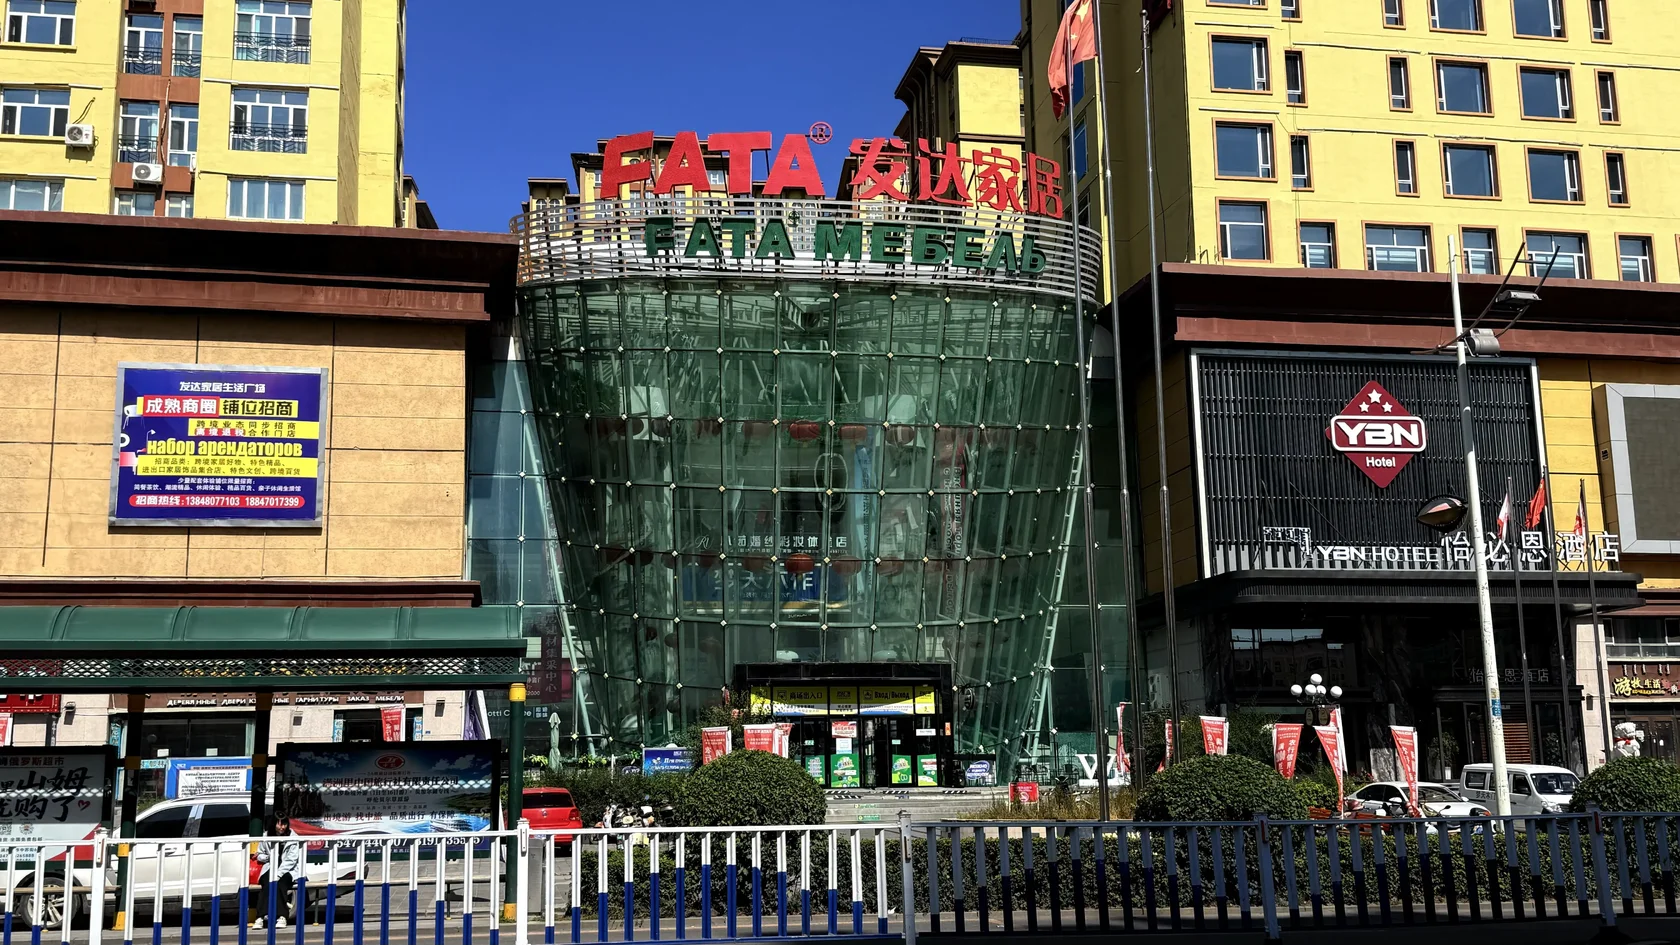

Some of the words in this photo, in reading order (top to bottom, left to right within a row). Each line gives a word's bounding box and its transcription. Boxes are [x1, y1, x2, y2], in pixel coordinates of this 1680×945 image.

[600, 130, 826, 199] FATA
[849, 137, 1063, 219] 发达家居
[645, 216, 796, 260] FATA
[814, 220, 1047, 274] МЕБЕЛЬ
[179, 381, 266, 394] 发达家居生活广场
[145, 398, 217, 415] 成熟商圈
[222, 400, 293, 416] 铺位招商
[196, 420, 297, 430] 跨境业态同步招商
[249, 429, 296, 438] 合作门店
[1336, 421, 1420, 446] YBN
[147, 438, 195, 456] набор
[198, 440, 303, 458] арендаторов
[1366, 456, 1396, 468] Hotel
[245, 496, 300, 507] 18847017399
[1316, 545, 1366, 561] YBN
[1371, 546, 1439, 562] HOTEL
[1441, 530, 1620, 563] 怡必恩酒店
[1470, 667, 1549, 684] 怡恩酒店
[347, 695, 370, 703] ЗАКАЗ
[487, 709, 502, 717] otti
